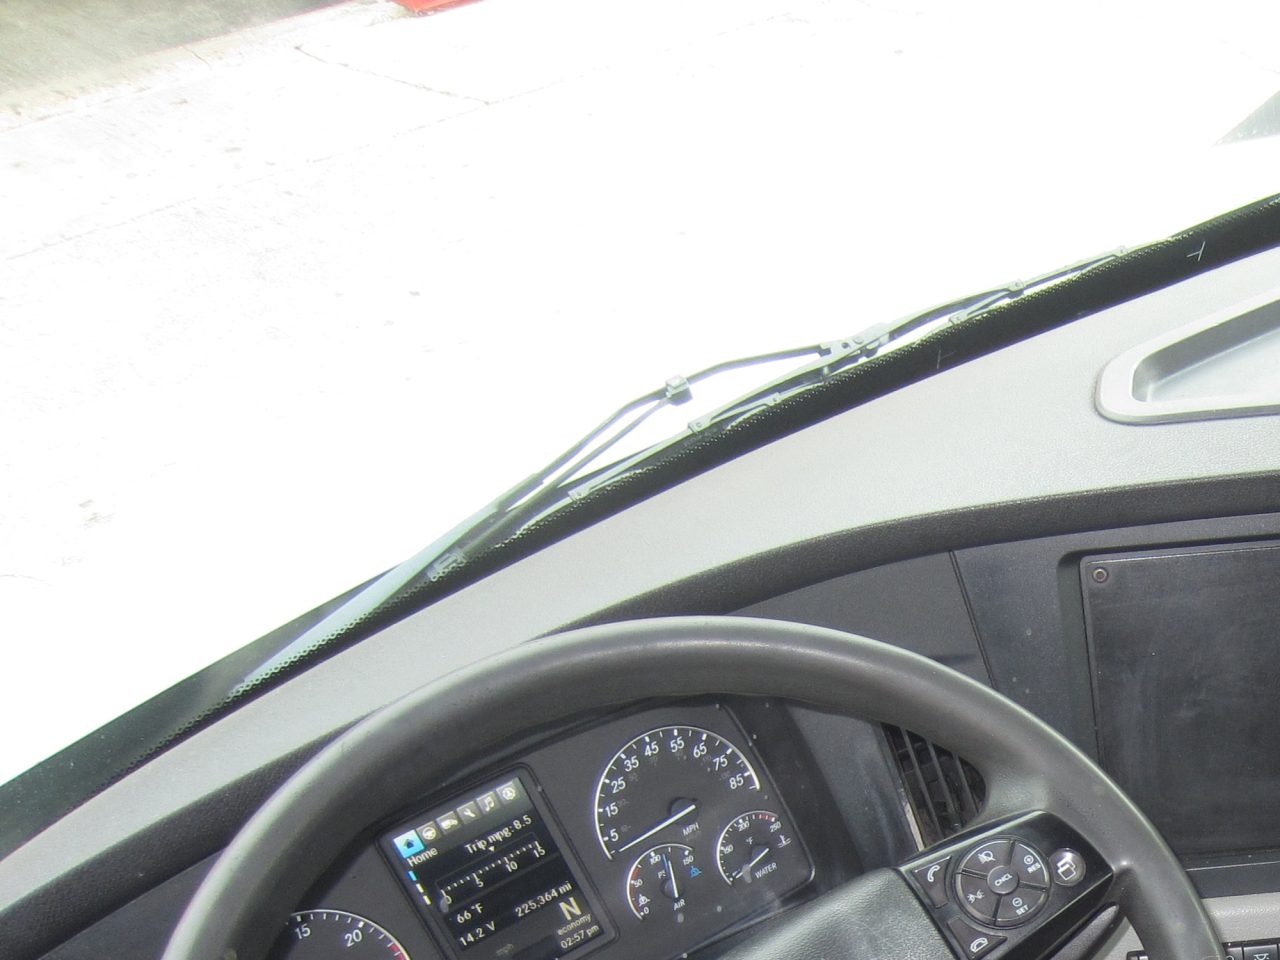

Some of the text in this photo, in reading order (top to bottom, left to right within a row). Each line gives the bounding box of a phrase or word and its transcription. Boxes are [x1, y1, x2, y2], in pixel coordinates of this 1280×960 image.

[644, 741, 659, 757] 45
[670, 736, 685, 753] 55
[693, 743, 708, 758] 65
[623, 755, 640, 772] 35
[712, 754, 729, 771] 75
[610, 776, 627, 793] 25
[729, 773, 745, 790] 85
[605, 804, 619, 818] 15
[464, 815, 532, 854] Trip mpg: 8.5
[610, 829, 620, 842] 5
[682, 823, 701, 837] MPH
[406, 848, 439, 867] Home
[533, 846, 546, 858] 15
[505, 861, 518, 873] 10
[754, 862, 779, 880] WATER
[1026, 862, 1042, 874] RES
[476, 878, 485, 888] 5
[514, 881, 573, 918] 225,364 mi
[673, 898, 686, 911] AIR
[456, 909, 472, 924] 66
[559, 896, 581, 921] N
[1016, 904, 1030, 916] SET
[294, 923, 312, 940] 15
[557, 913, 592, 936] economy
[344, 929, 363, 948] 20
[459, 921, 496, 947] 14.2 V
[560, 924, 600, 950] 02:57 pm
